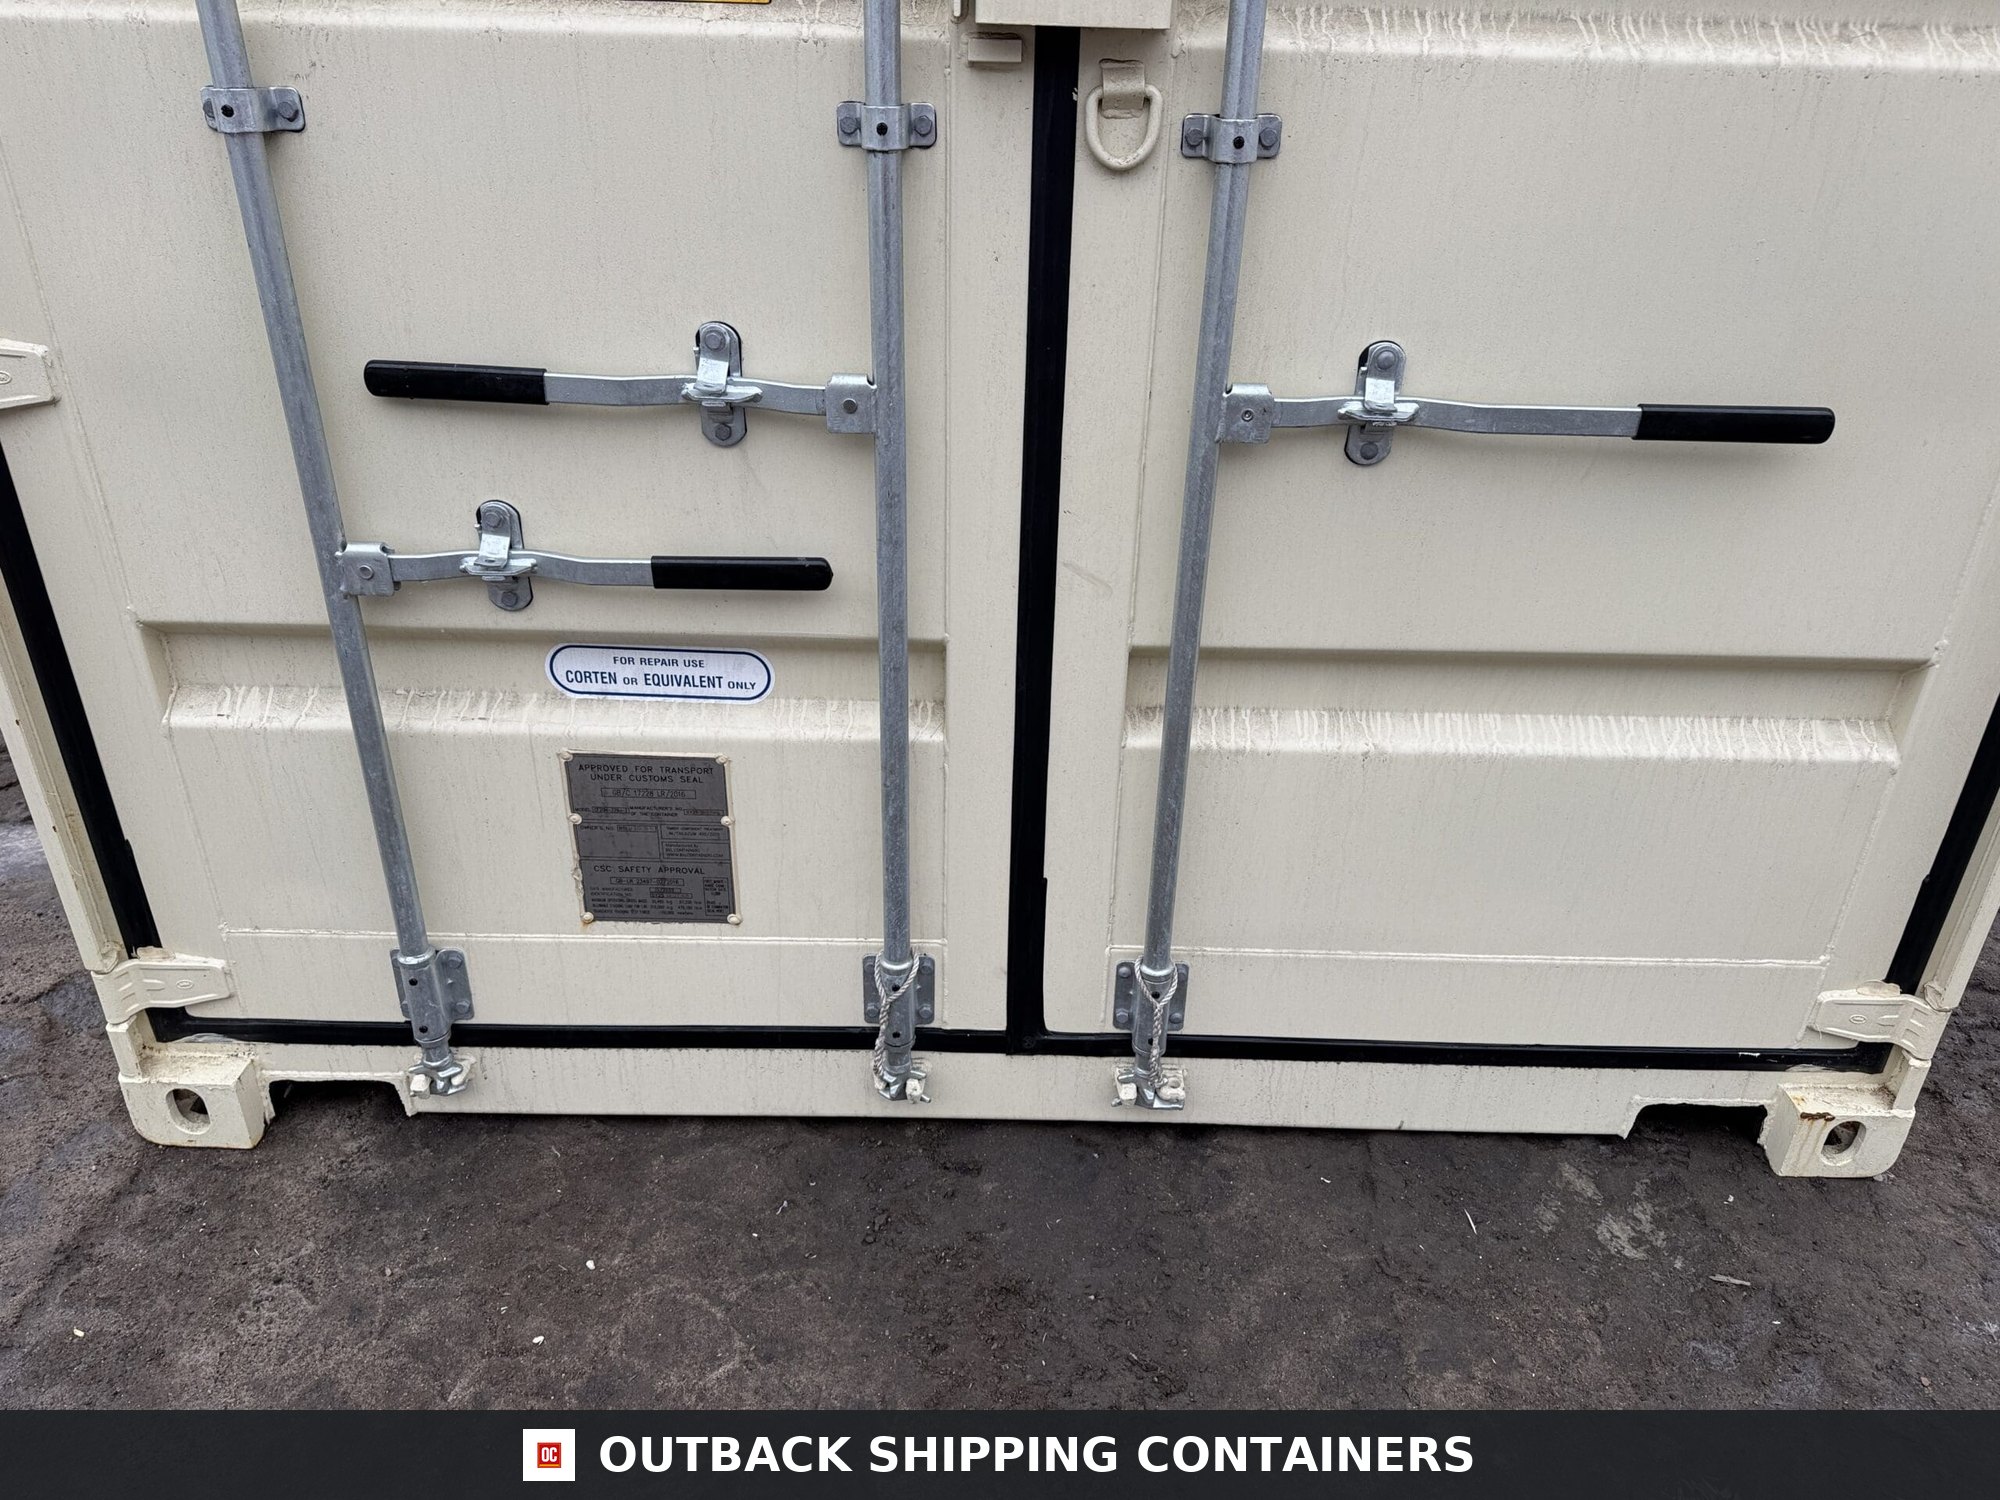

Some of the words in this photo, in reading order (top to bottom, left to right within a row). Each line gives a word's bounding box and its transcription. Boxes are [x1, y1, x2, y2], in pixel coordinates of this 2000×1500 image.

[613, 656, 635, 666] FOR
[640, 657, 679, 668] REPAIR
[683, 658, 705, 669] USE
[565, 669, 617, 685] CORTEN
[623, 676, 638, 686] OR
[644, 672, 723, 690] EQUIVALENT
[728, 680, 756, 690] ONLY
[578, 764, 628, 773] APPROVED
[635, 765, 653, 774] FOR
[661, 766, 714, 775] TRANSPORT
[590, 773, 622, 782] UNDER
[629, 774, 674, 783] CUSTOMS
[680, 775, 704, 784] SEAL
[593, 865, 612, 873] CSC
[618, 866, 651, 874] SAFETY
[658, 866, 705, 875] APPROVAL
